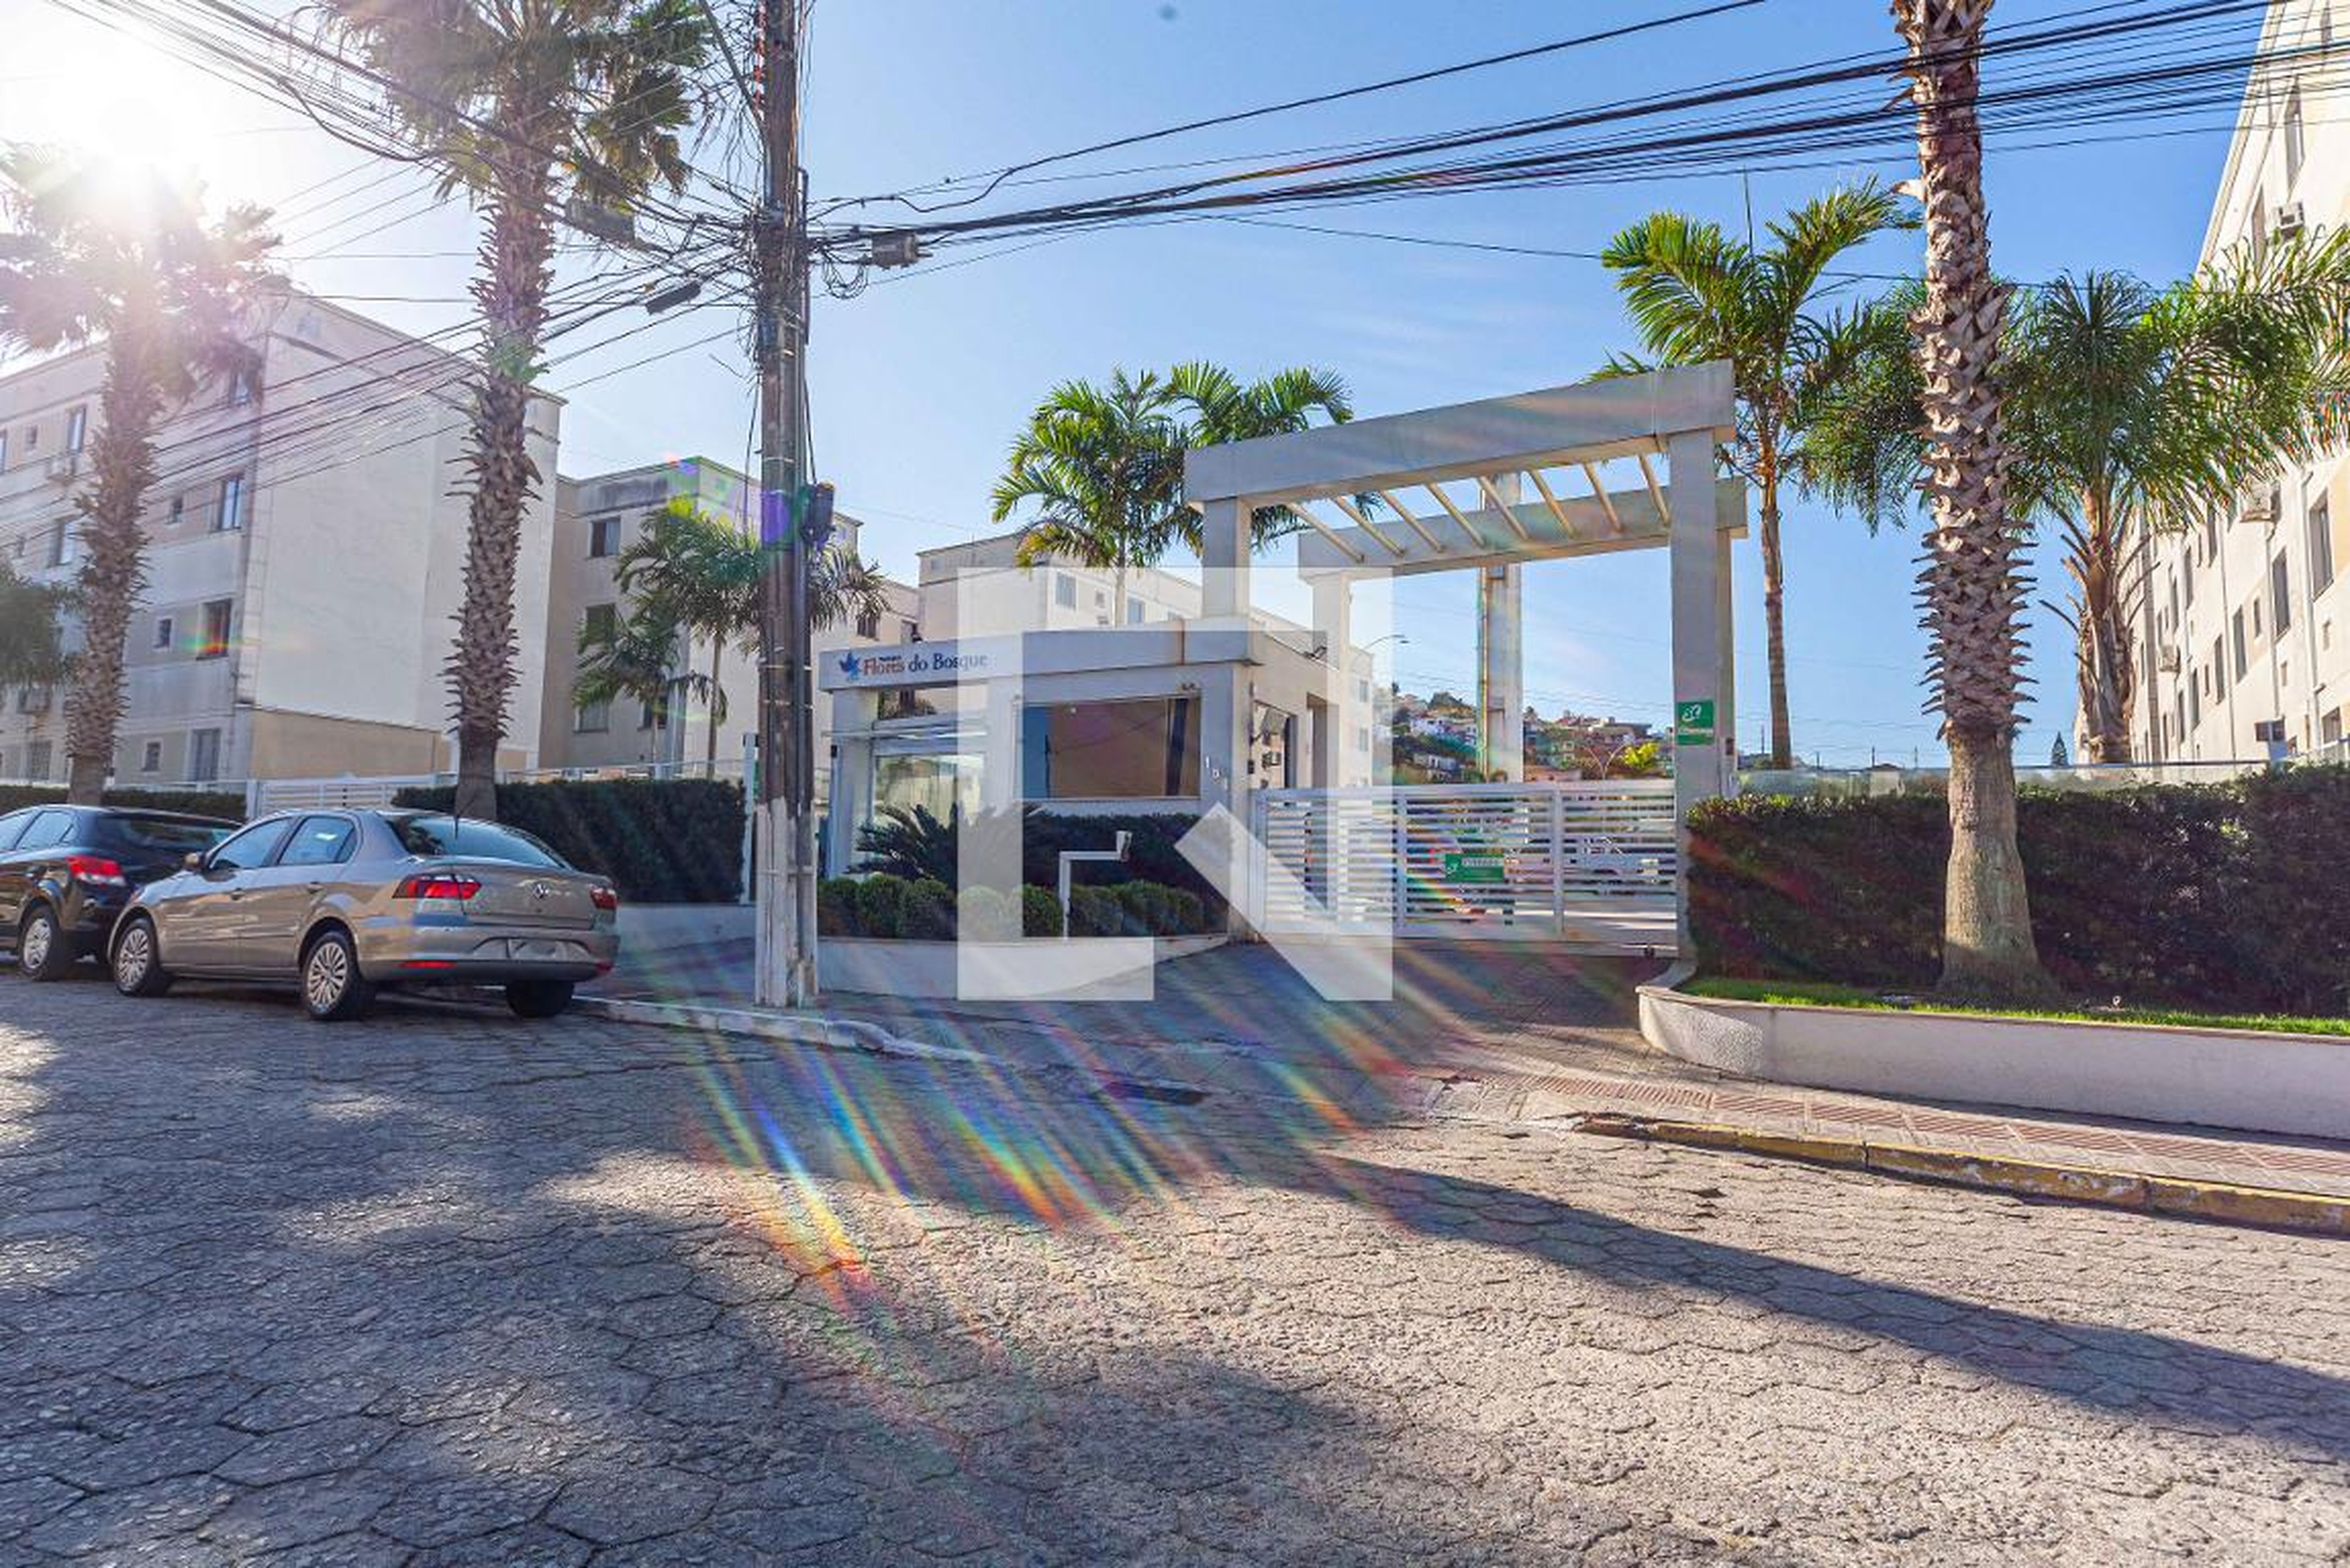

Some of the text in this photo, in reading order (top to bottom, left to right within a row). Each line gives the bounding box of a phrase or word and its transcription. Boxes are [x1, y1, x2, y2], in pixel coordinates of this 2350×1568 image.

[864, 652, 988, 676] Flores do Bosque
